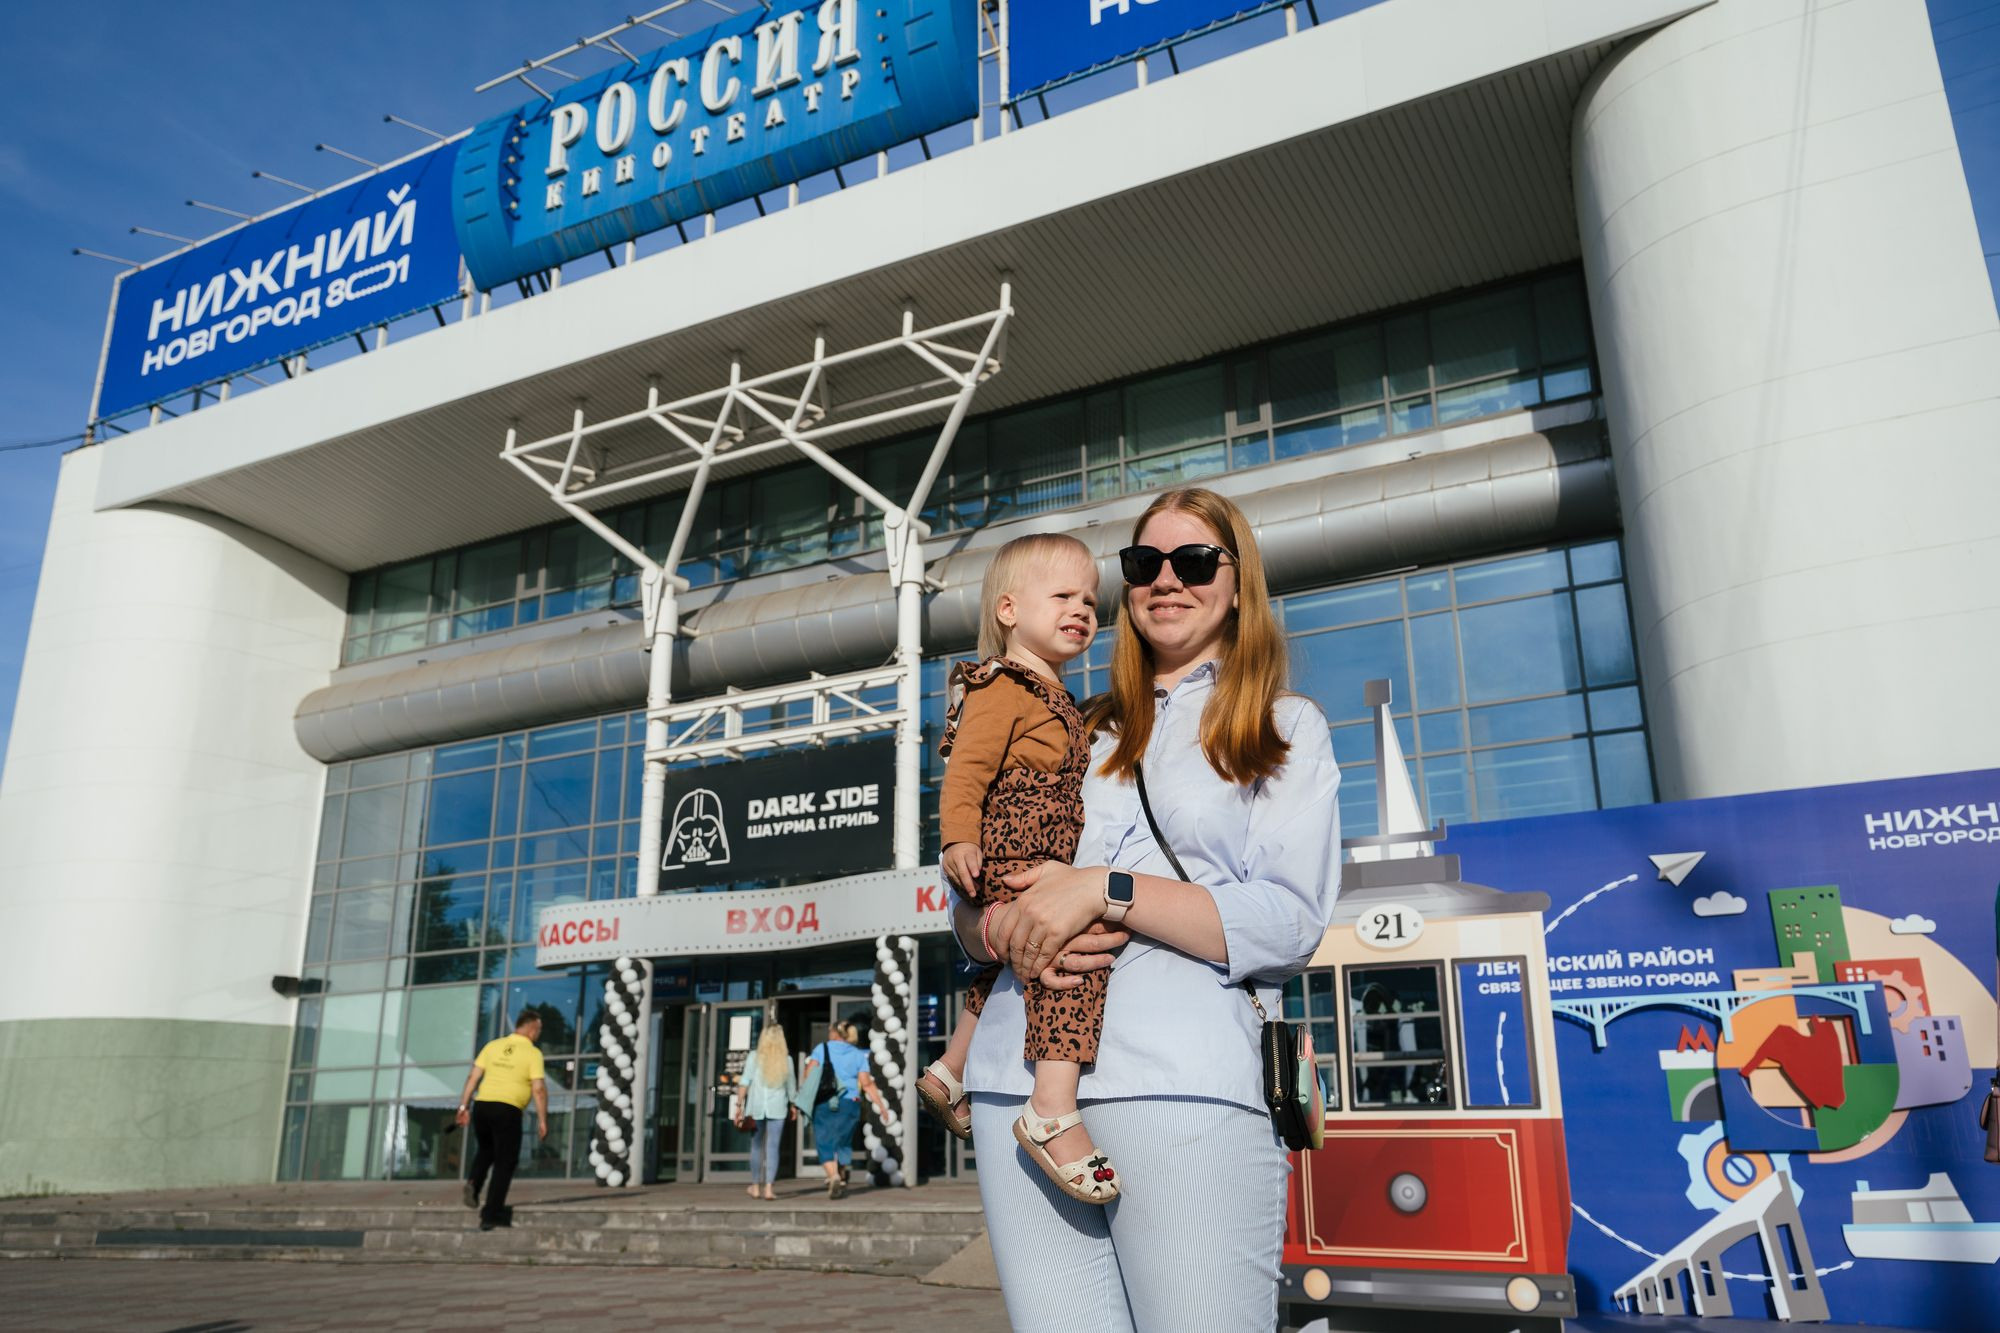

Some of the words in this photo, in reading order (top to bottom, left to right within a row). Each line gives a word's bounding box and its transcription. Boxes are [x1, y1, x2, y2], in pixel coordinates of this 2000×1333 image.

[545, 0, 861, 177] РОССИЯ
[545, 69, 861, 211] КИНОТЕАТР
[147, 183, 417, 341] НИЖНИЙ
[141, 286, 321, 376] НОВГОРОД
[748, 792, 816, 820] DARK
[820, 784, 879, 811] SIDE
[1864, 802, 2000, 834] НИЖН
[747, 818, 816, 839] ШАУРМА
[818, 817, 827, 830] &
[829, 811, 880, 829] ГРИЛЬ
[539, 917, 620, 947] КАССЫ
[725, 902, 819, 935] ВХОД
[1373, 913, 1406, 940] 21
[1628, 946, 1714, 968] РАЙОН
[1586, 975, 1643, 990] ЗВЕНО
[1645, 971, 1720, 987] ГОРОДА
